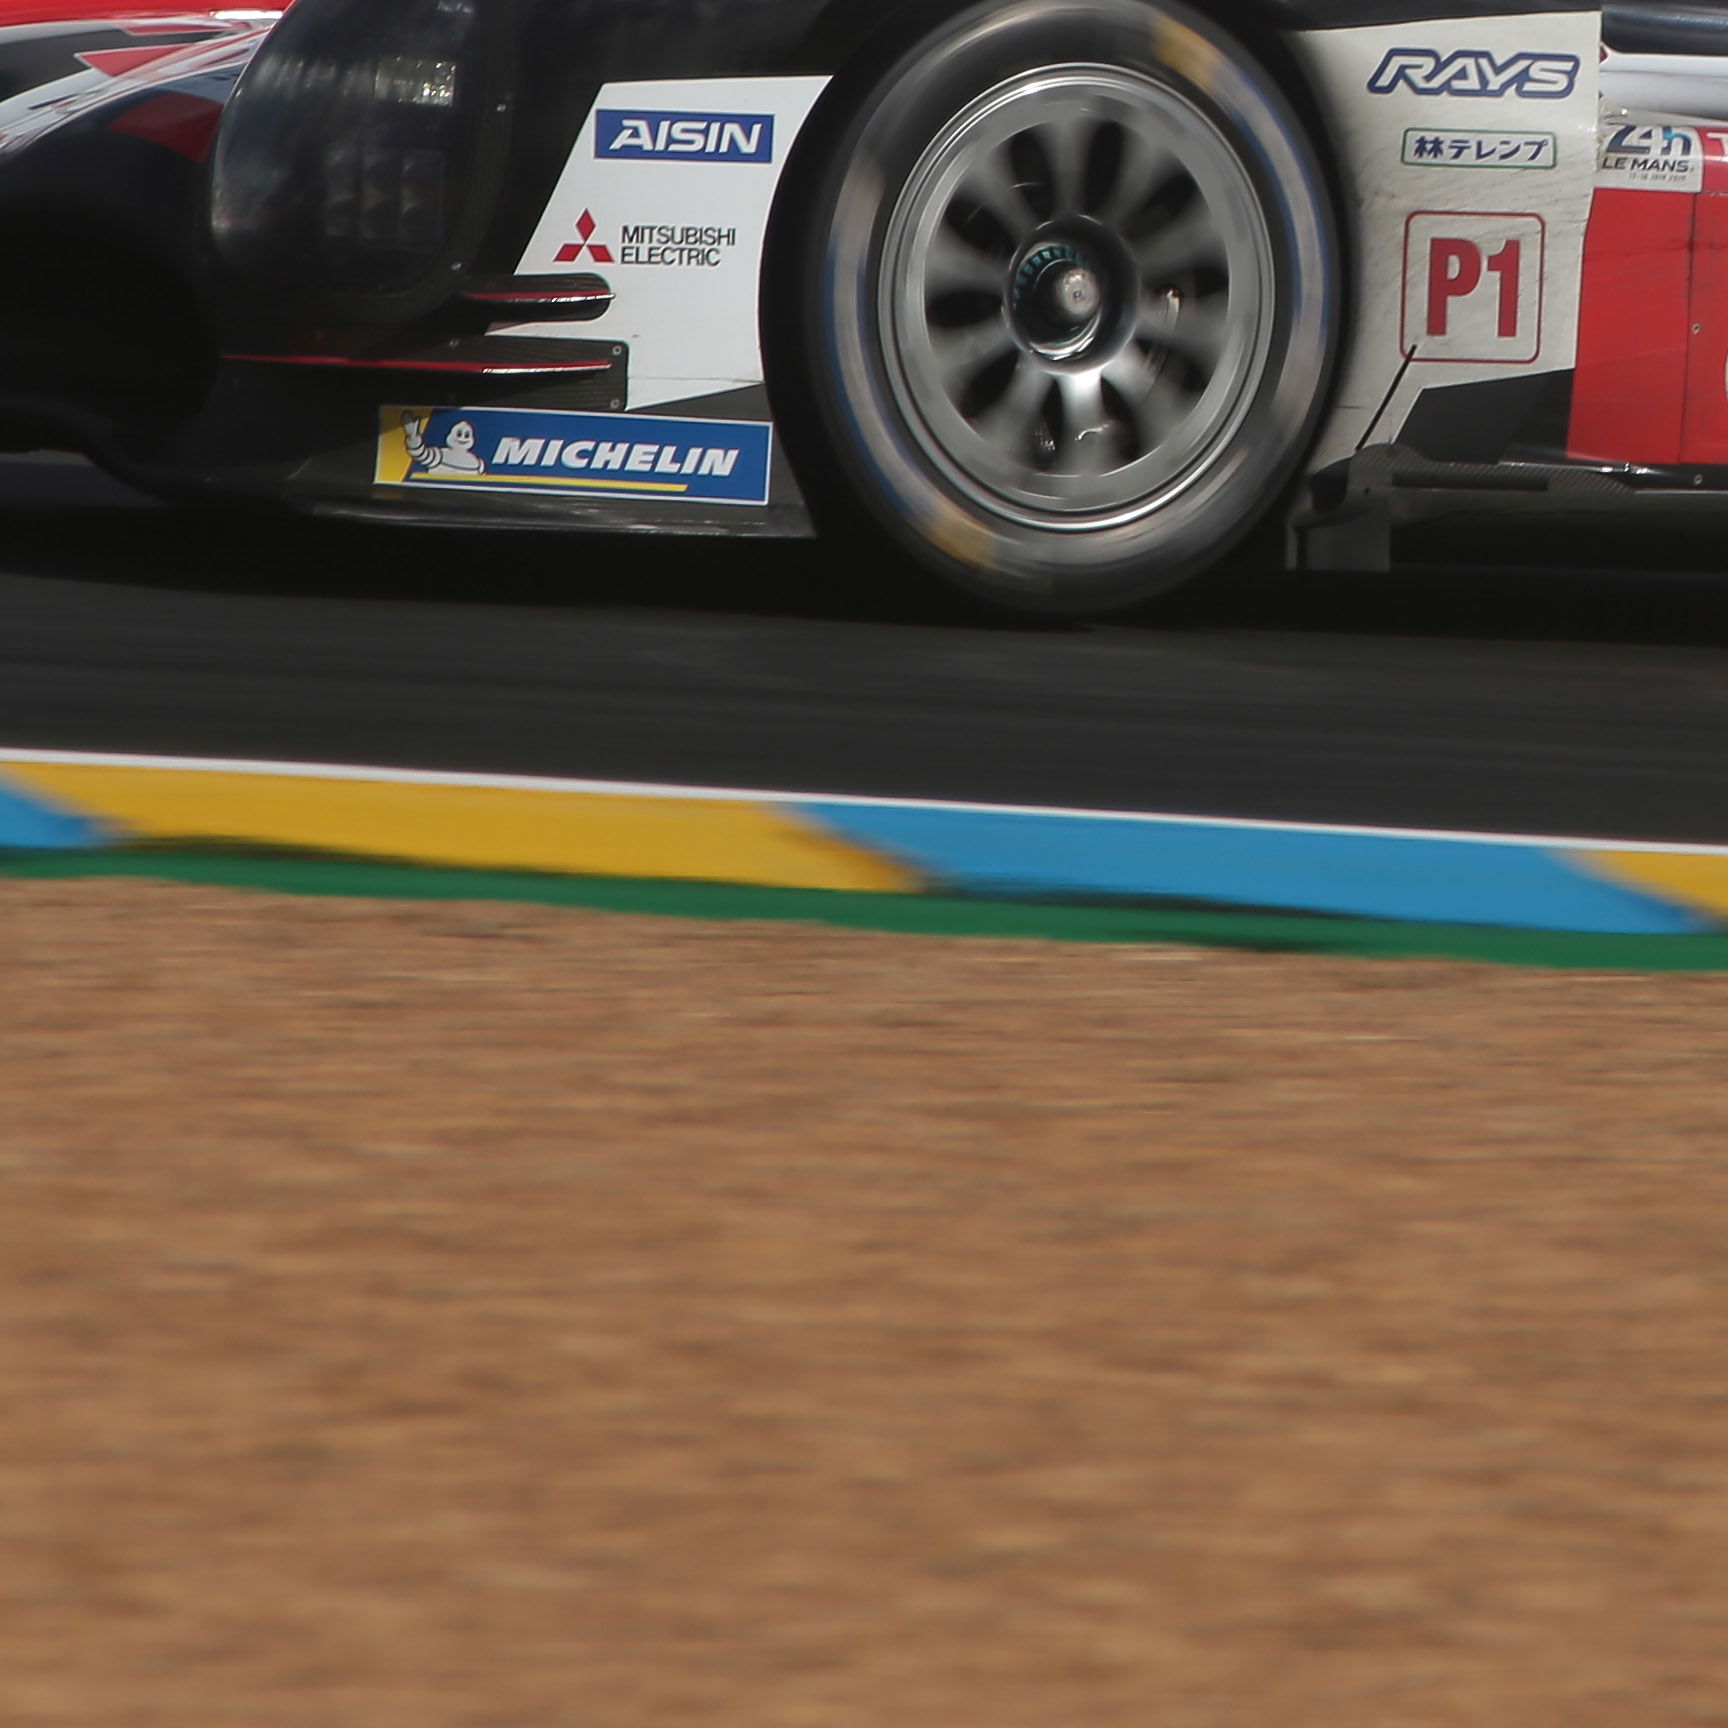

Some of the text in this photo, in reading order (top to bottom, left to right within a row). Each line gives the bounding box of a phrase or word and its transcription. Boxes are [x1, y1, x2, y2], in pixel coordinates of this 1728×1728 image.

[1367, 47, 1580, 99] RAYS
[608, 118, 762, 154] AISIN
[1412, 134, 1549, 162] 林テレンプ
[1602, 156, 1690, 173] LE MANS
[620, 225, 736, 246] MITSUBISHI
[620, 245, 722, 267] ELECTRIC
[1425, 237, 1520, 339] P1
[492, 436, 739, 477] MICHELIN
